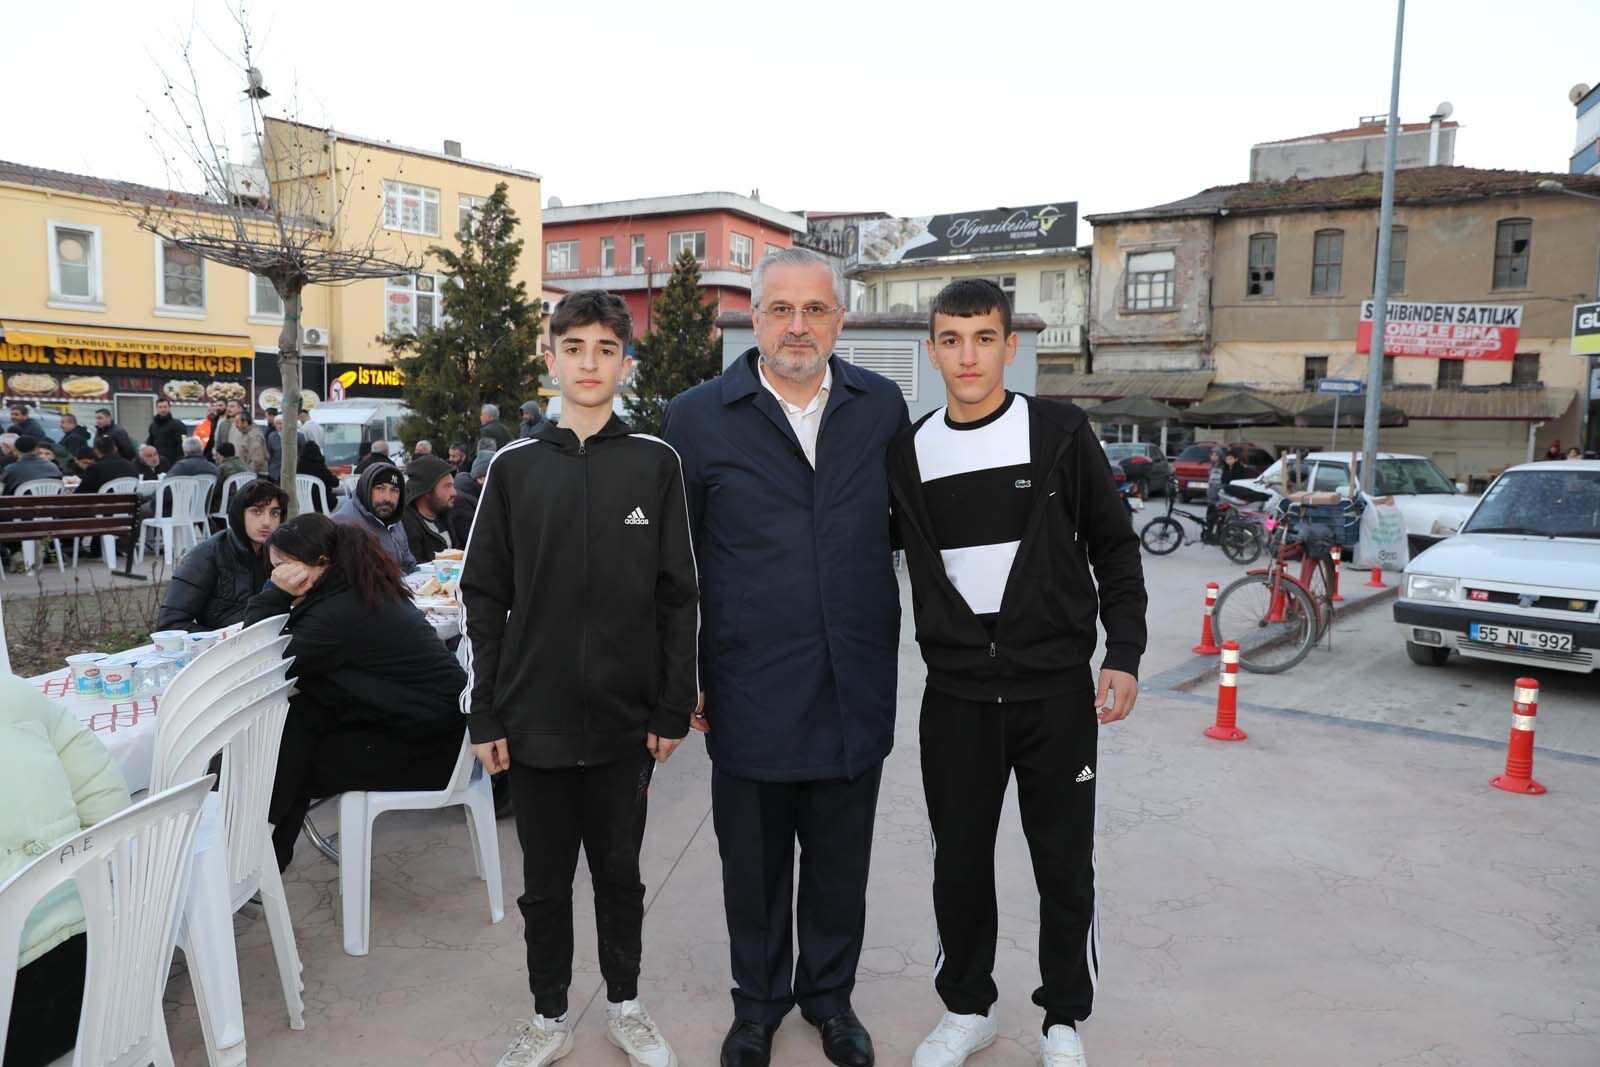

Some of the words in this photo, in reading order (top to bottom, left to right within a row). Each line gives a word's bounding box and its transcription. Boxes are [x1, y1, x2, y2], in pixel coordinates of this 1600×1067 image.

[1456, 306, 1519, 326] SATILIK
[1386, 322, 1449, 339] OMPLE
[624, 517, 649, 525] adidas
[1479, 626, 1499, 641] 55
[1506, 630, 1529, 646] NL
[1537, 633, 1571, 651] 992
[1075, 772, 1095, 783] adidas
